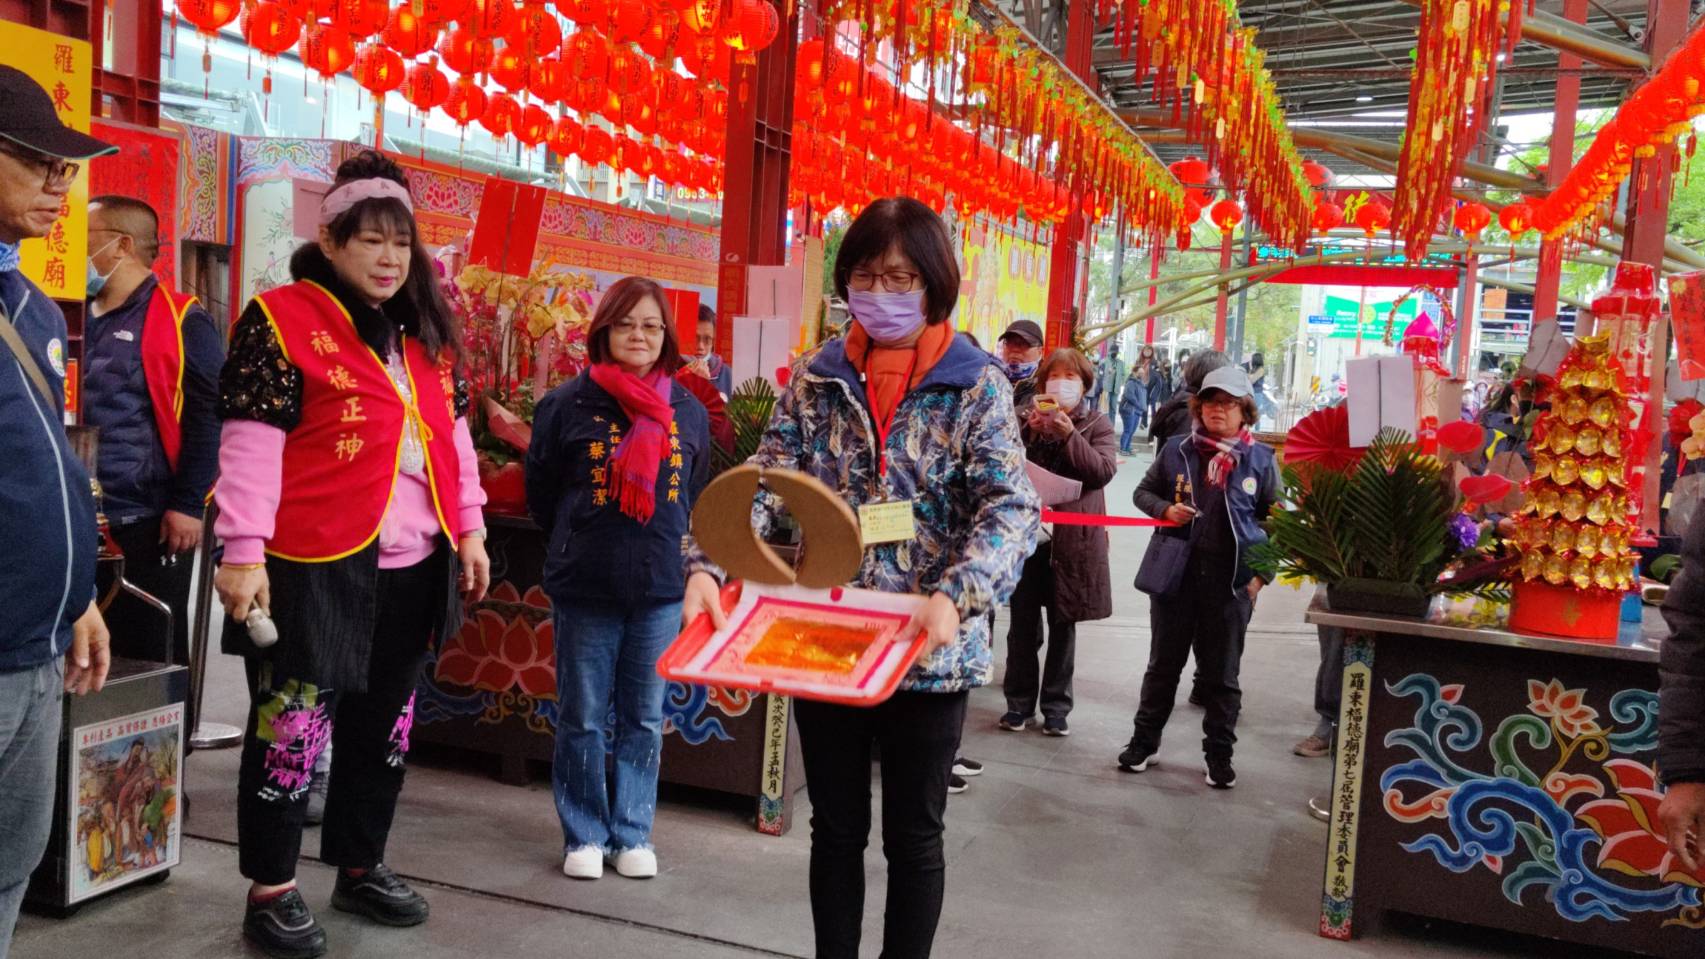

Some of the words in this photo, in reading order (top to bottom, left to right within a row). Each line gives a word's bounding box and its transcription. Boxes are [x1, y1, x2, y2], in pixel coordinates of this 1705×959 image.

[43, 44, 75, 289] 羅東福德廟
[311, 331, 367, 461] 福德正神
